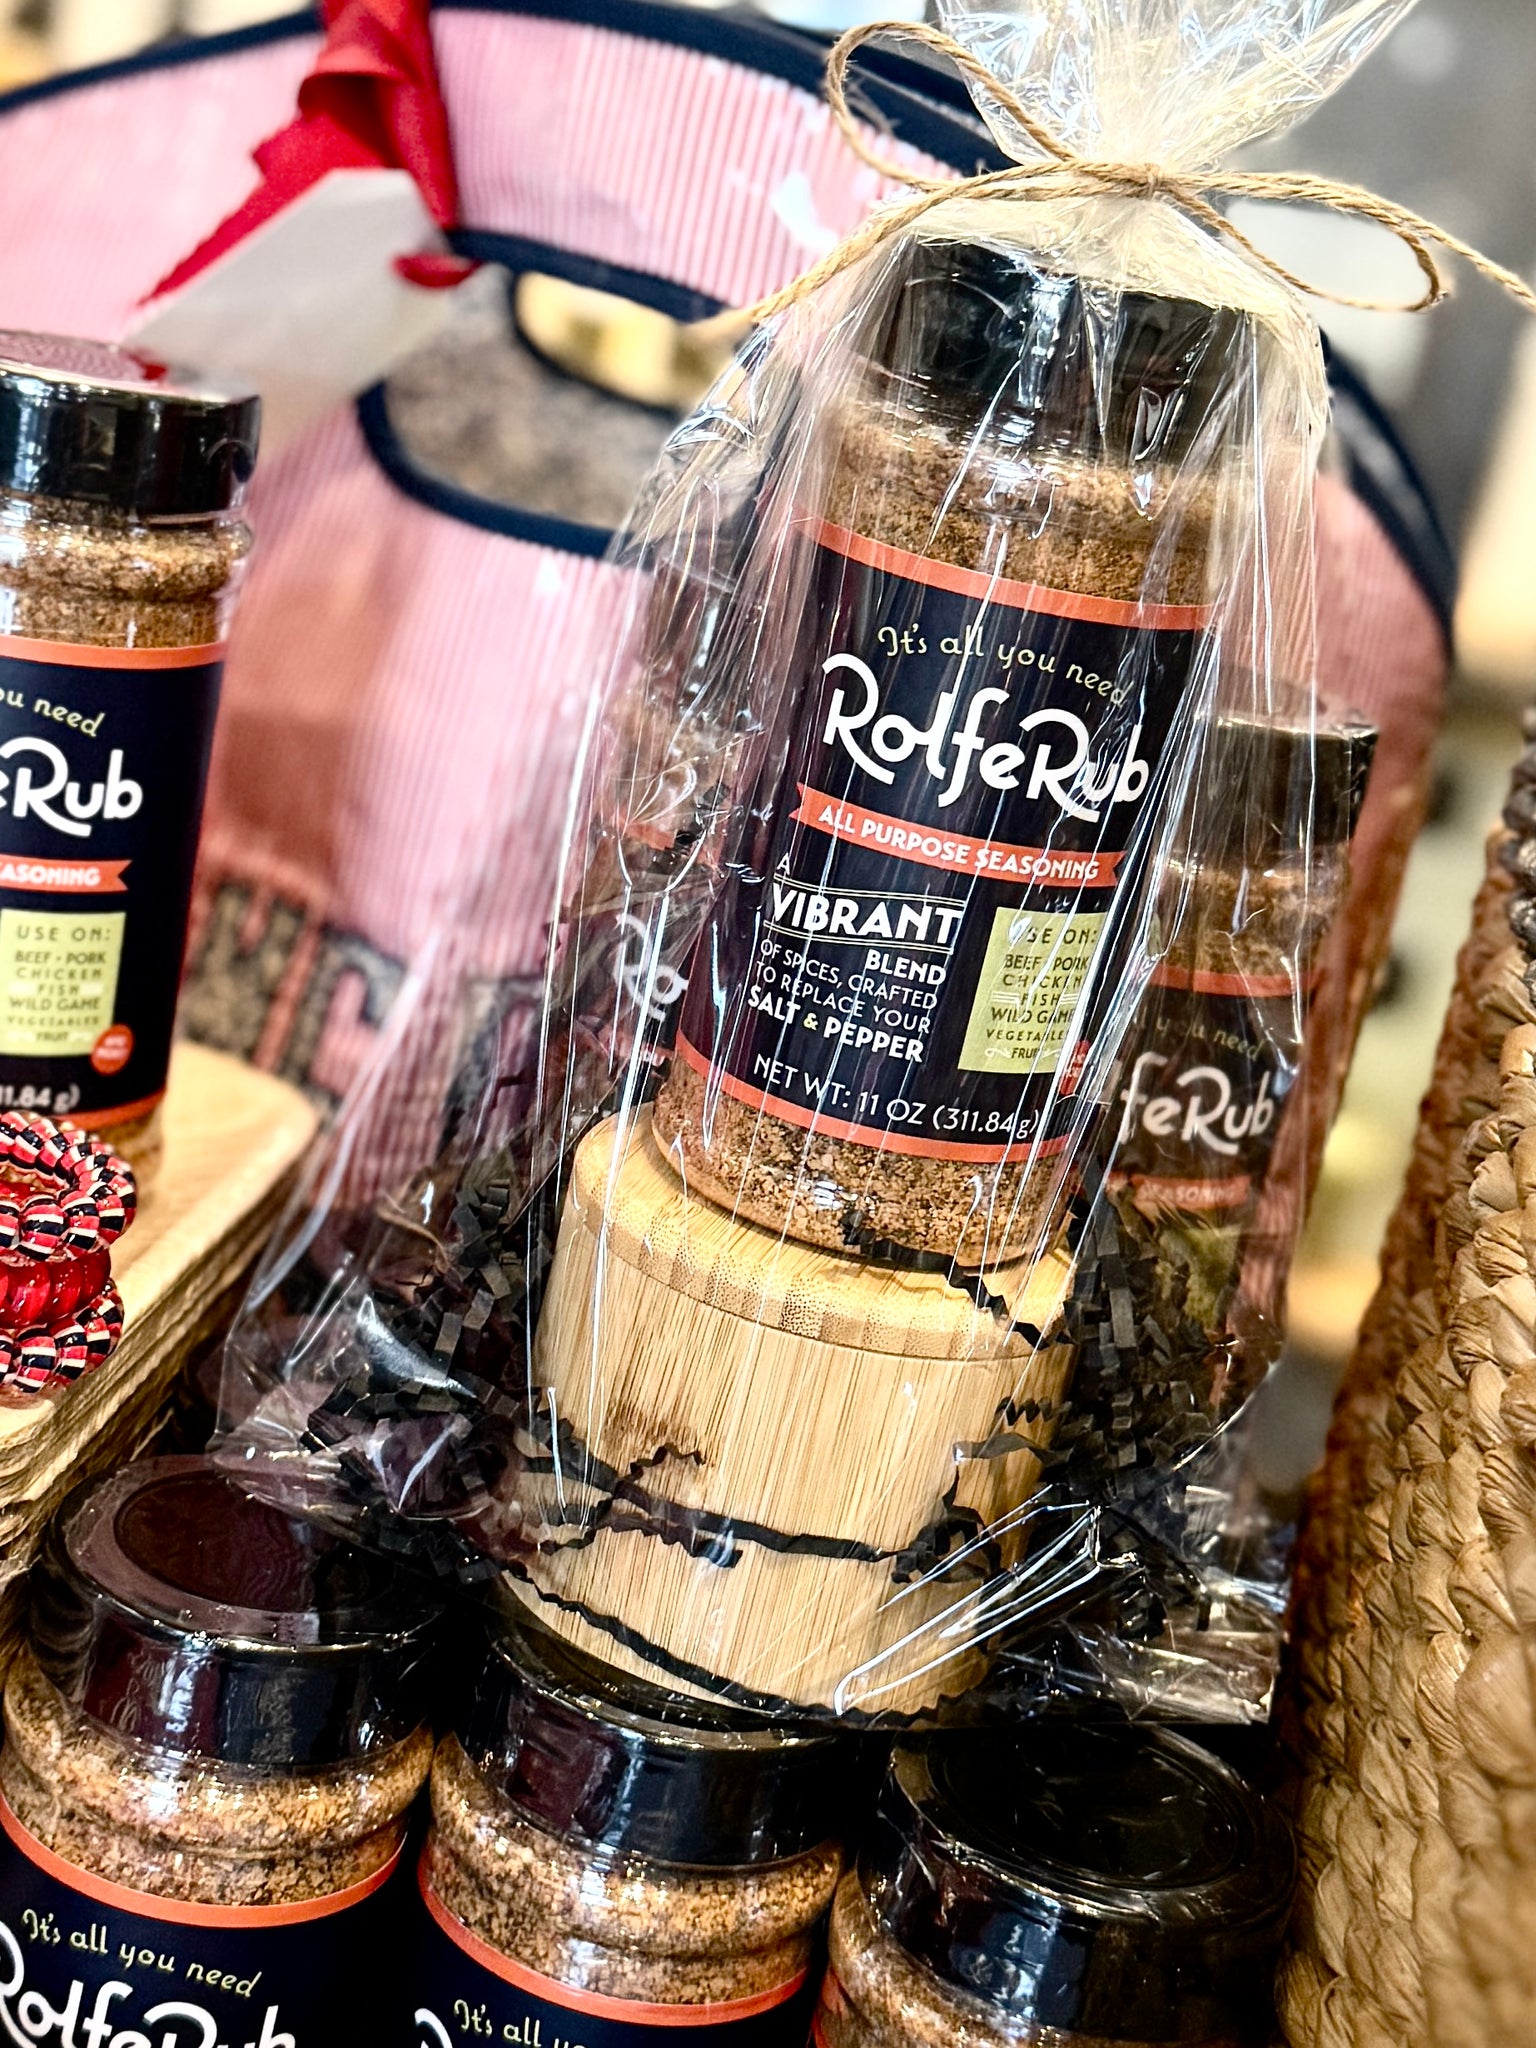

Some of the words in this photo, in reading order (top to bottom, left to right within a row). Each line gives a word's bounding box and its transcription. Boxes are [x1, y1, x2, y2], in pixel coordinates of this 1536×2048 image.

[878, 623, 928, 657] It's
[940, 625, 984, 657] all
[998, 644, 1056, 673] you
[1066, 664, 1134, 707] need
[34, 698, 105, 737] need
[821, 652, 1150, 823] RolfeRub
[0, 736, 143, 838] Rub
[818, 805, 855, 834] ALL
[861, 819, 971, 865] PURPOSE
[974, 848, 1100, 880] SEASONING
[0, 863, 101, 887] ASONING
[776, 853, 791, 876] A
[771, 882, 965, 944] VIBRANT
[16, 926, 59, 941] USE
[72, 926, 111, 942] ON:
[1018, 926, 1053, 944] SE
[1062, 928, 1098, 945] ON:
[15, 950, 50, 964] BEEF
[66, 951, 106, 965] PORK
[865, 949, 946, 985] BLEND
[1003, 953, 1043, 971] BEEF
[16, 967, 103, 981] CHICKEN
[760, 938, 782, 960] OF
[783, 949, 842, 988] SPCES,
[848, 974, 937, 1010] CRAFTED
[10, 997, 51, 1011] WILD
[57, 997, 101, 1012] GAME
[38, 984, 80, 996] FISH
[756, 960, 777, 983] TO
[780, 973, 866, 1018] REPLACE
[873, 1005, 932, 1034] YOUR
[1020, 992, 1062, 1007] FISH
[748, 984, 801, 1024] SALT
[803, 1012, 819, 1031] &
[823, 1015, 924, 1063] PEPPER
[991, 1006, 1033, 1024] WILD
[1157, 1016, 1206, 1038] yu
[985, 1028, 1067, 1042] VEGETALE
[1011, 1047, 1042, 1059] FRUI
[753, 1054, 798, 1089] NET
[804, 1071, 849, 1108] WT:
[858, 1091, 878, 1116] 11
[886, 1099, 928, 1125] OZ
[1120, 1051, 1275, 1156] feRub
[22, 1908, 61, 1944] It's
[70, 1923, 109, 1954] all
[120, 1943, 175, 1971] you
[186, 1962, 263, 1998] need
[454, 1999, 493, 2037] It's
[503, 2016, 542, 2047] all
